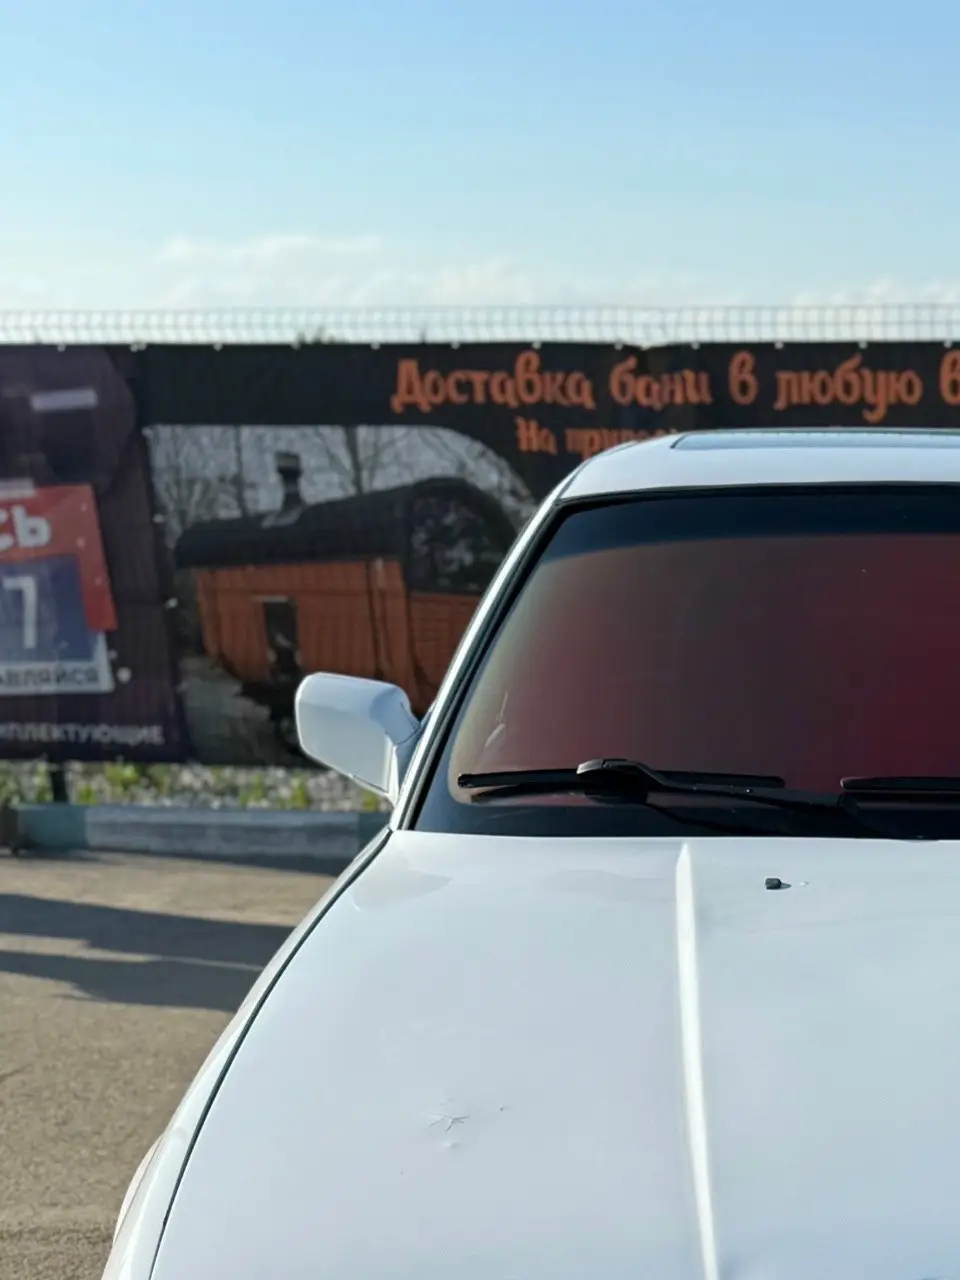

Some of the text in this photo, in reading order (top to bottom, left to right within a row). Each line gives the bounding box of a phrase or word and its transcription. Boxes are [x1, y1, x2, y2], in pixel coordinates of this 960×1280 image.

[391, 350, 595, 413] Доставка
[610, 354, 713, 410] бани
[729, 350, 758, 404] в
[774, 353, 923, 423] любую
